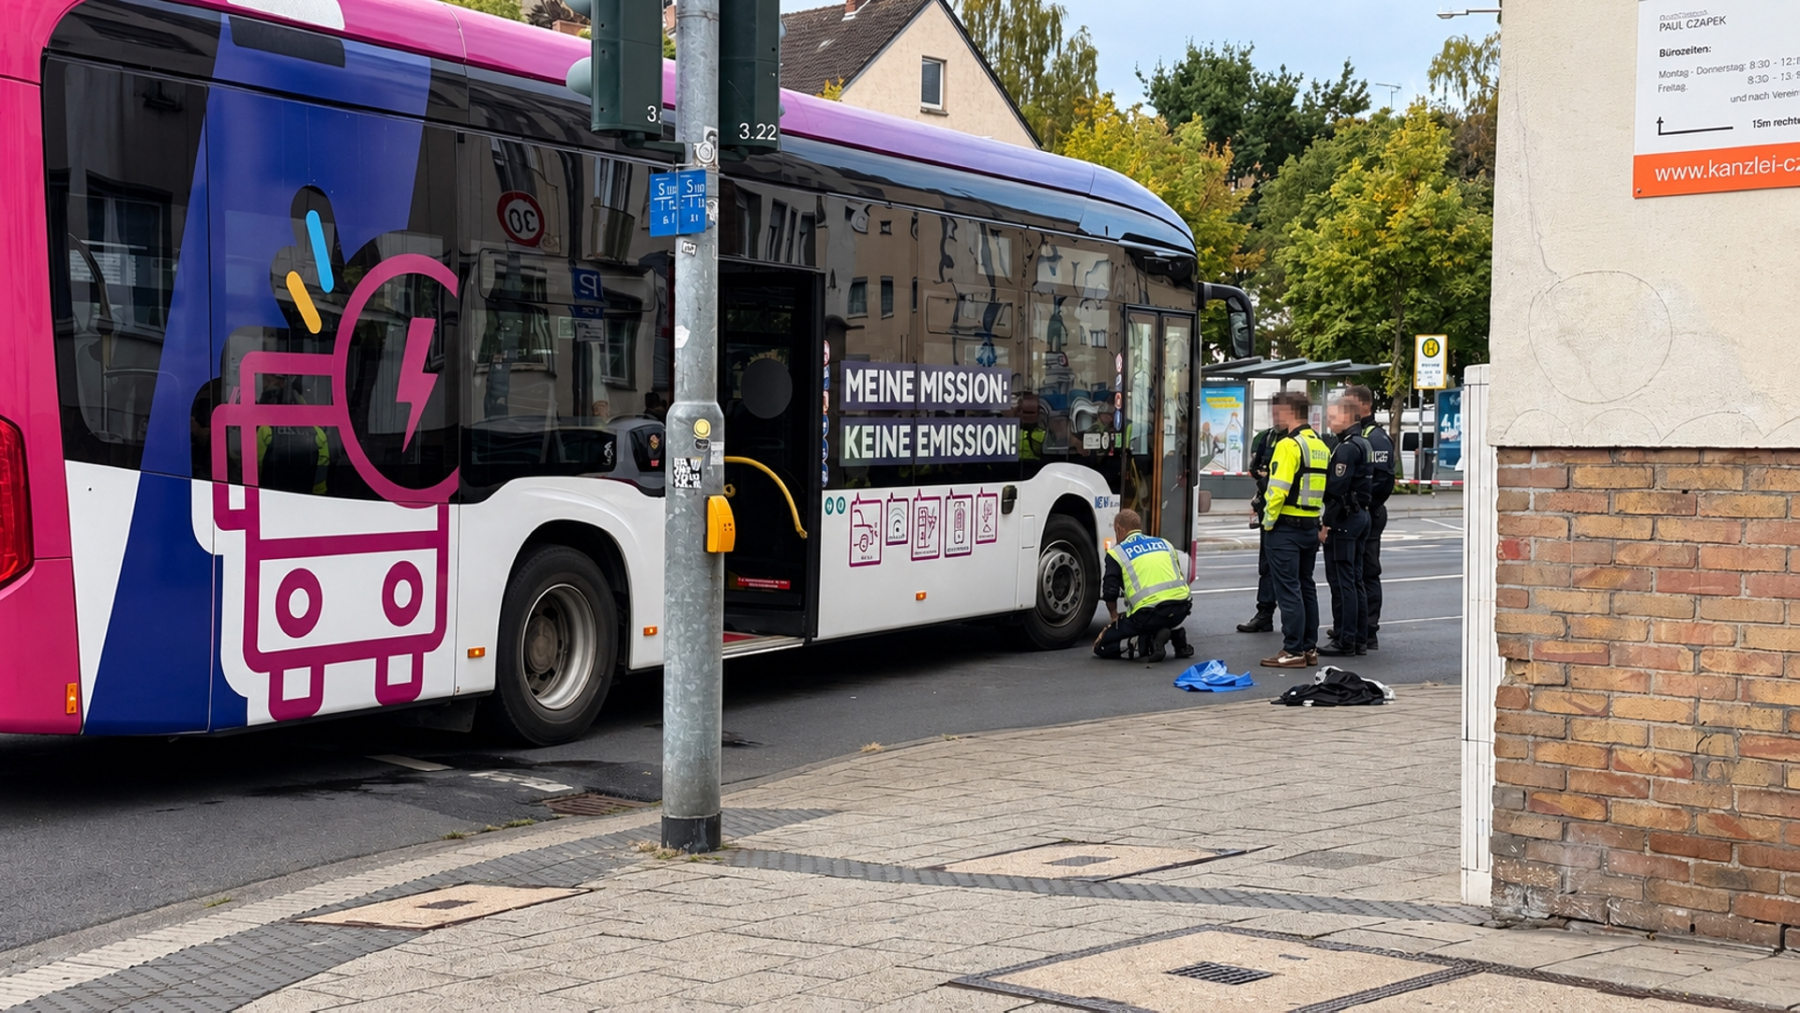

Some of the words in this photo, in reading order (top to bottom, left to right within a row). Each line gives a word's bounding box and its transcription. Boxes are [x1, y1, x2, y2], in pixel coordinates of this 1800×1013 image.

[1659, 20, 1683, 32] PAUL
[1686, 15, 1727, 29] CZAPEK
[1659, 45, 1712, 57] Bürozeiten:
[739, 122, 777, 140] 3.22
[845, 368, 915, 403] MEINE
[919, 370, 1008, 404] MISSION:
[844, 424, 911, 459] KEINE
[916, 424, 1017, 458] EMISSION!
